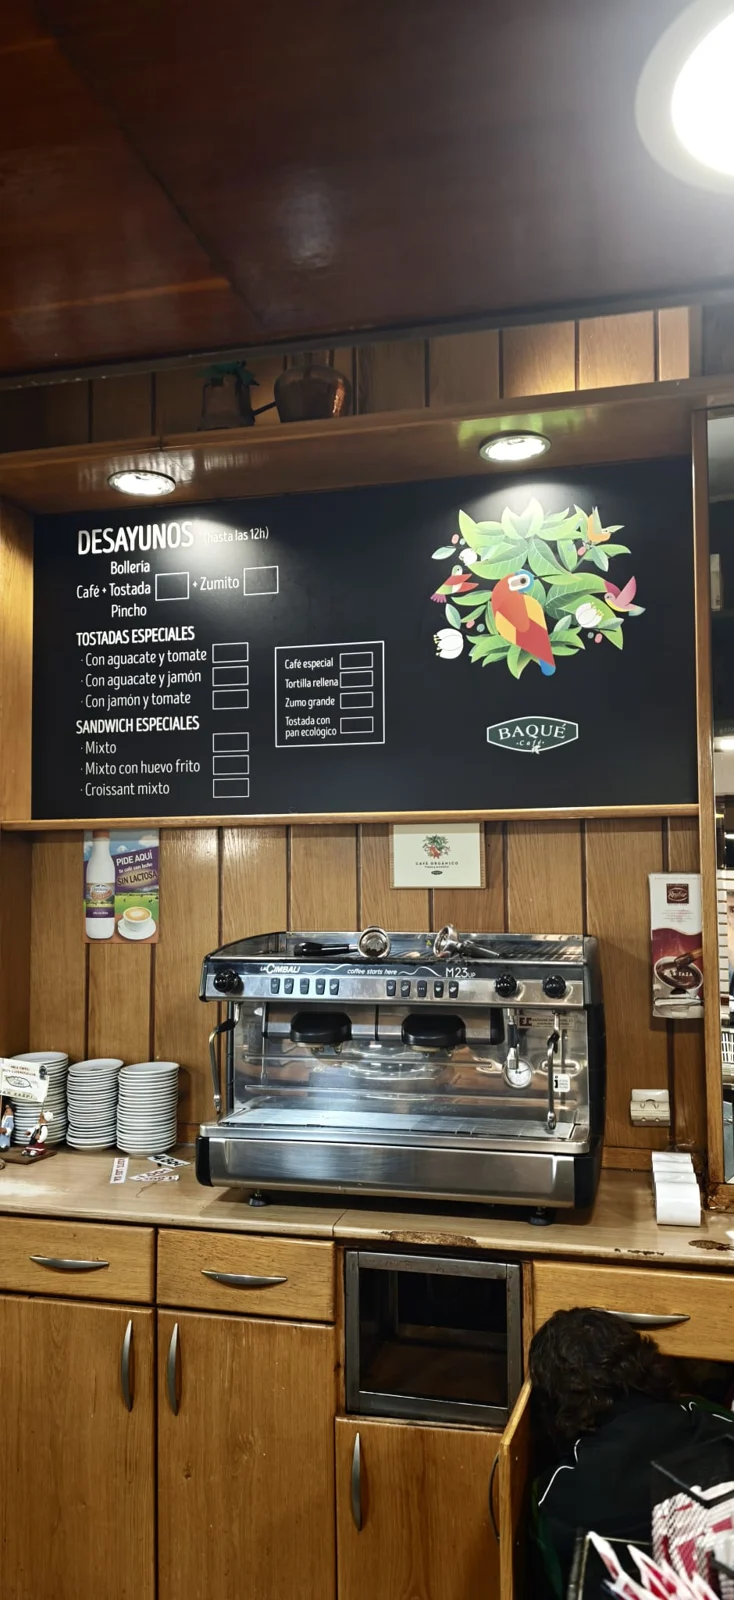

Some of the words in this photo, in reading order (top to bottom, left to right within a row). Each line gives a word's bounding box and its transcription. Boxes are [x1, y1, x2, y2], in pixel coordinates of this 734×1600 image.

[78, 521, 194, 555] DESAYUNOS
[235, 529, 249, 541] las
[250, 526, 269, 540] 12h)
[76, 584, 100, 599] Café
[109, 581, 151, 597] Tostada
[200, 576, 240, 590] Zumito
[111, 603, 147, 618] Pincho
[76, 630, 129, 646] TOSTADAS
[132, 626, 195, 642] ESPECIALES
[85, 653, 105, 667] Con
[107, 651, 156, 669] aguacate
[159, 653, 165, 667] y
[167, 649, 207, 662] tomate
[285, 659, 301, 669] Café
[302, 657, 334, 670] especial
[85, 674, 105, 687] Con
[107, 672, 156, 690] aguacate
[159, 674, 165, 688] y
[167, 670, 201, 687] jamón
[285, 678, 311, 688] Tortilla
[313, 677, 339, 687] rellena
[85, 694, 105, 708] Con
[107, 693, 141, 711] jamón
[143, 695, 149, 709] y
[151, 691, 191, 705] tomate
[285, 698, 306, 707] Zumo
[308, 696, 335, 709] grande
[76, 718, 133, 734] SANDWICH
[136, 716, 200, 732] ESPECIALES
[285, 716, 315, 726] Tostada
[316, 717, 330, 725] con
[285, 730, 300, 740] pan
[499, 723, 566, 740] BAQUÉ
[85, 741, 117, 754] Mixto
[85, 762, 117, 775] Mixto
[119, 764, 138, 774] con
[141, 760, 173, 774] huevo
[175, 759, 200, 773] frito
[85, 782, 135, 796] Croissant
[137, 782, 170, 795] mixto
[116, 856, 134, 866] PIDE
[135, 850, 153, 862] AQUÍ
[118, 877, 129, 885] SIN
[130, 870, 157, 883] LACTOSA
